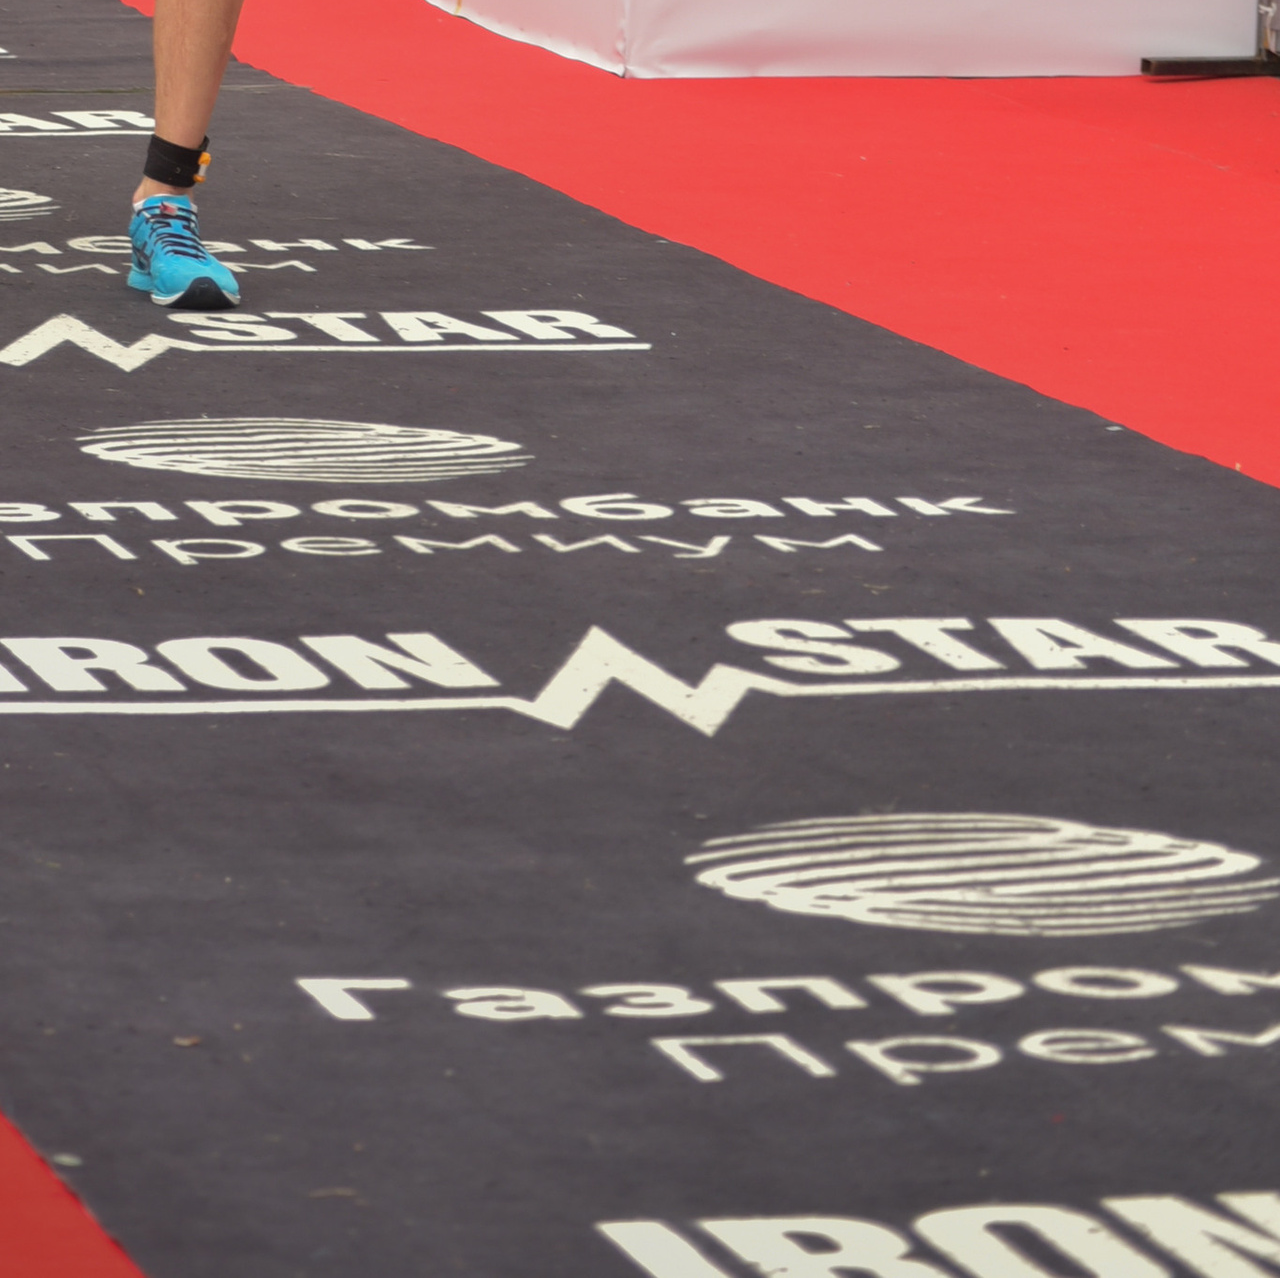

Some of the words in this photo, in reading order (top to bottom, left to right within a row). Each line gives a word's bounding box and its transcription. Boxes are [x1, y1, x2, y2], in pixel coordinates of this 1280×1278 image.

[166, 310, 638, 343] STAR
[5, 533, 884, 565] Премиум
[725, 617, 1280, 676] STAR
